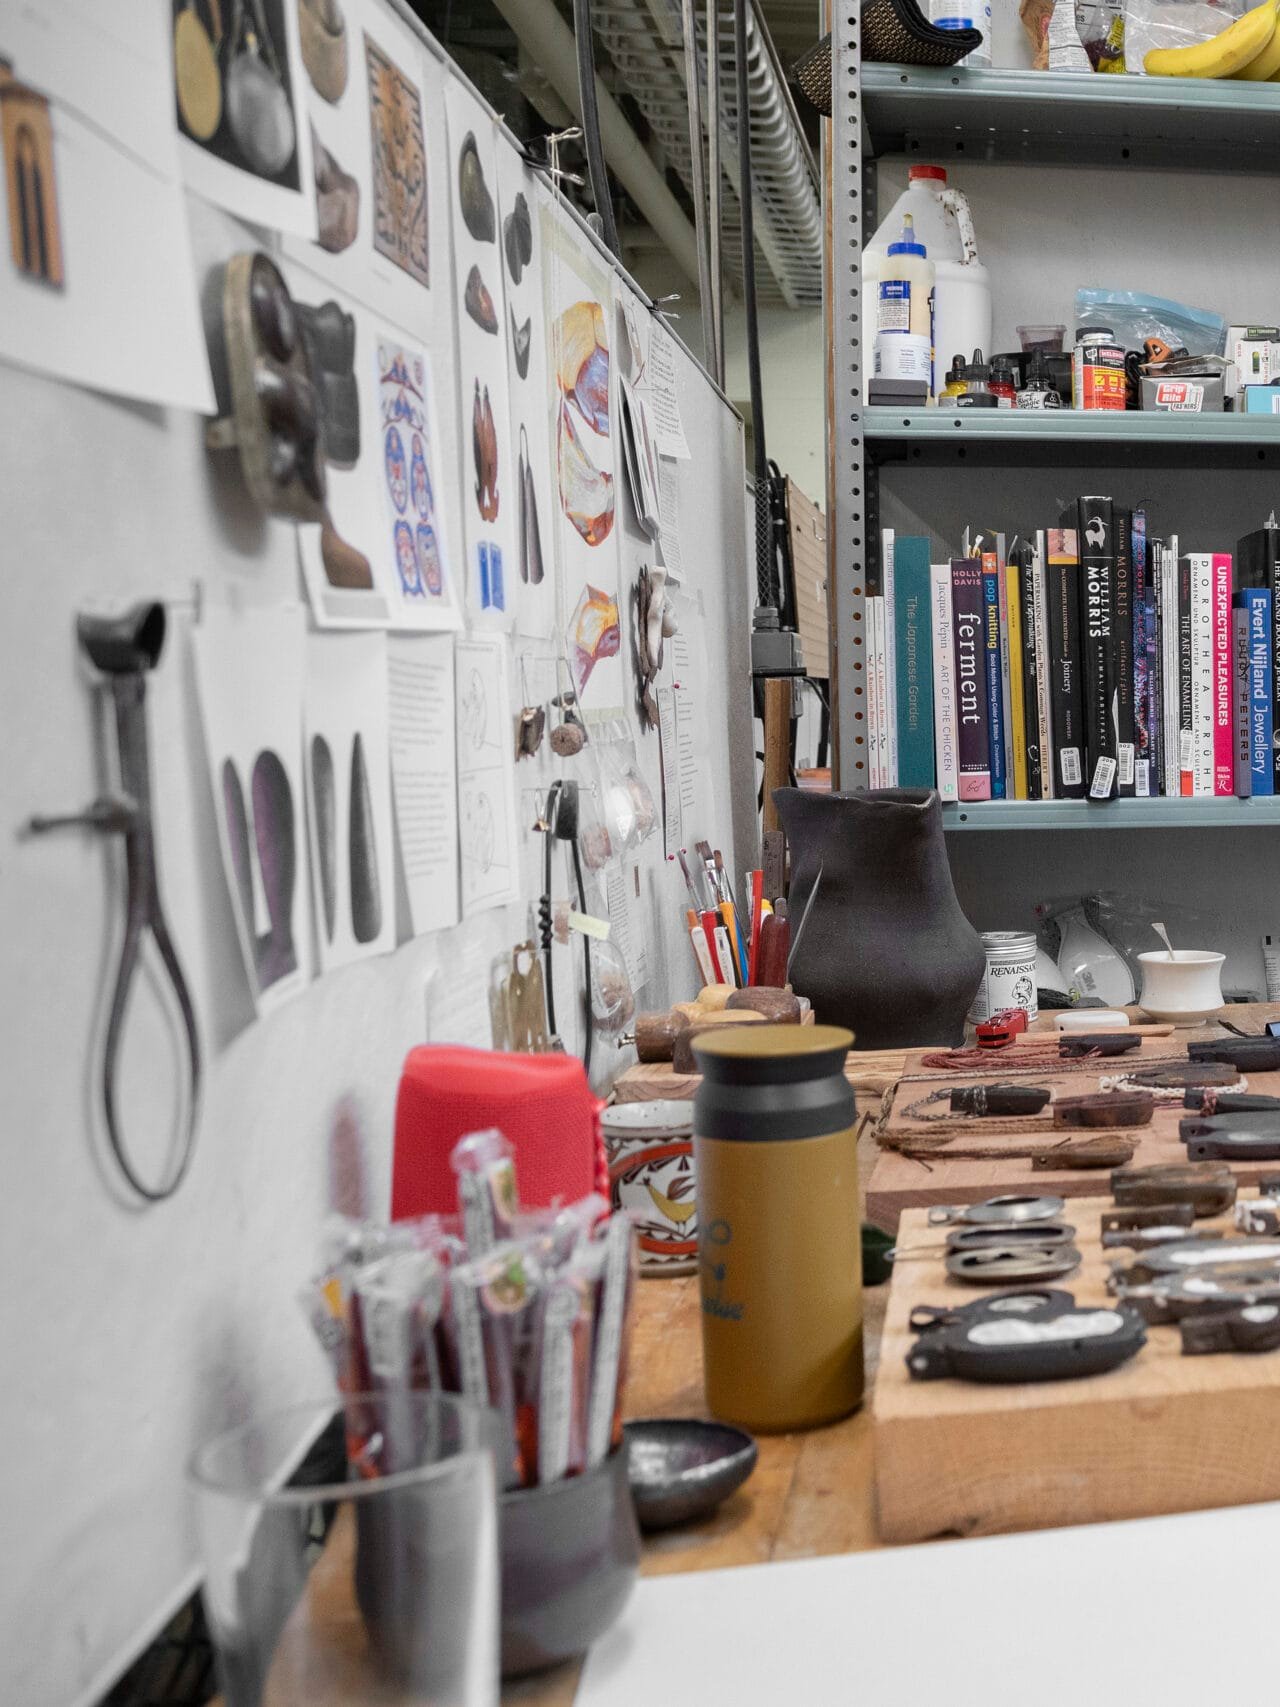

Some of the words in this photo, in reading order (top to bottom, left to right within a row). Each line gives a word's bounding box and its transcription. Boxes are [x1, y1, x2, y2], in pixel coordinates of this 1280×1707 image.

[1162, 393, 1182, 402] Rite
[1163, 384, 1184, 393] Grip
[985, 580, 996, 602] pop
[1026, 564, 1034, 577] The
[1026, 580, 1034, 592] Art
[1117, 556, 1128, 616] MORRIS
[907, 596, 918, 618] The
[936, 580, 948, 618] Jacques
[1088, 566, 1101, 638] MORRIS
[1100, 566, 1110, 637] WILLIAM
[1217, 566, 1228, 650] UNEXPECTED
[1252, 598, 1267, 639] Evert
[987, 604, 998, 649] knitting
[1182, 614, 1190, 634] THE
[1201, 560, 1210, 692] DOROTHEA
[906, 622, 918, 682] Japanese
[958, 612, 982, 724] ferment
[1182, 638, 1190, 656] ART
[1182, 658, 1191, 672] OF
[940, 665, 948, 684] ART
[1060, 658, 1072, 694] Joinery
[1218, 652, 1228, 726] PLEASURES
[1250, 643, 1268, 699] Nijland
[908, 686, 919, 731] Garden
[942, 687, 950, 700] OF
[942, 704, 950, 722] THE
[1239, 693, 1248, 762] PETERS
[1251, 705, 1268, 774] Jewellery
[943, 727, 952, 772] CHICKEN
[1202, 716, 1212, 791] PRÜHL
